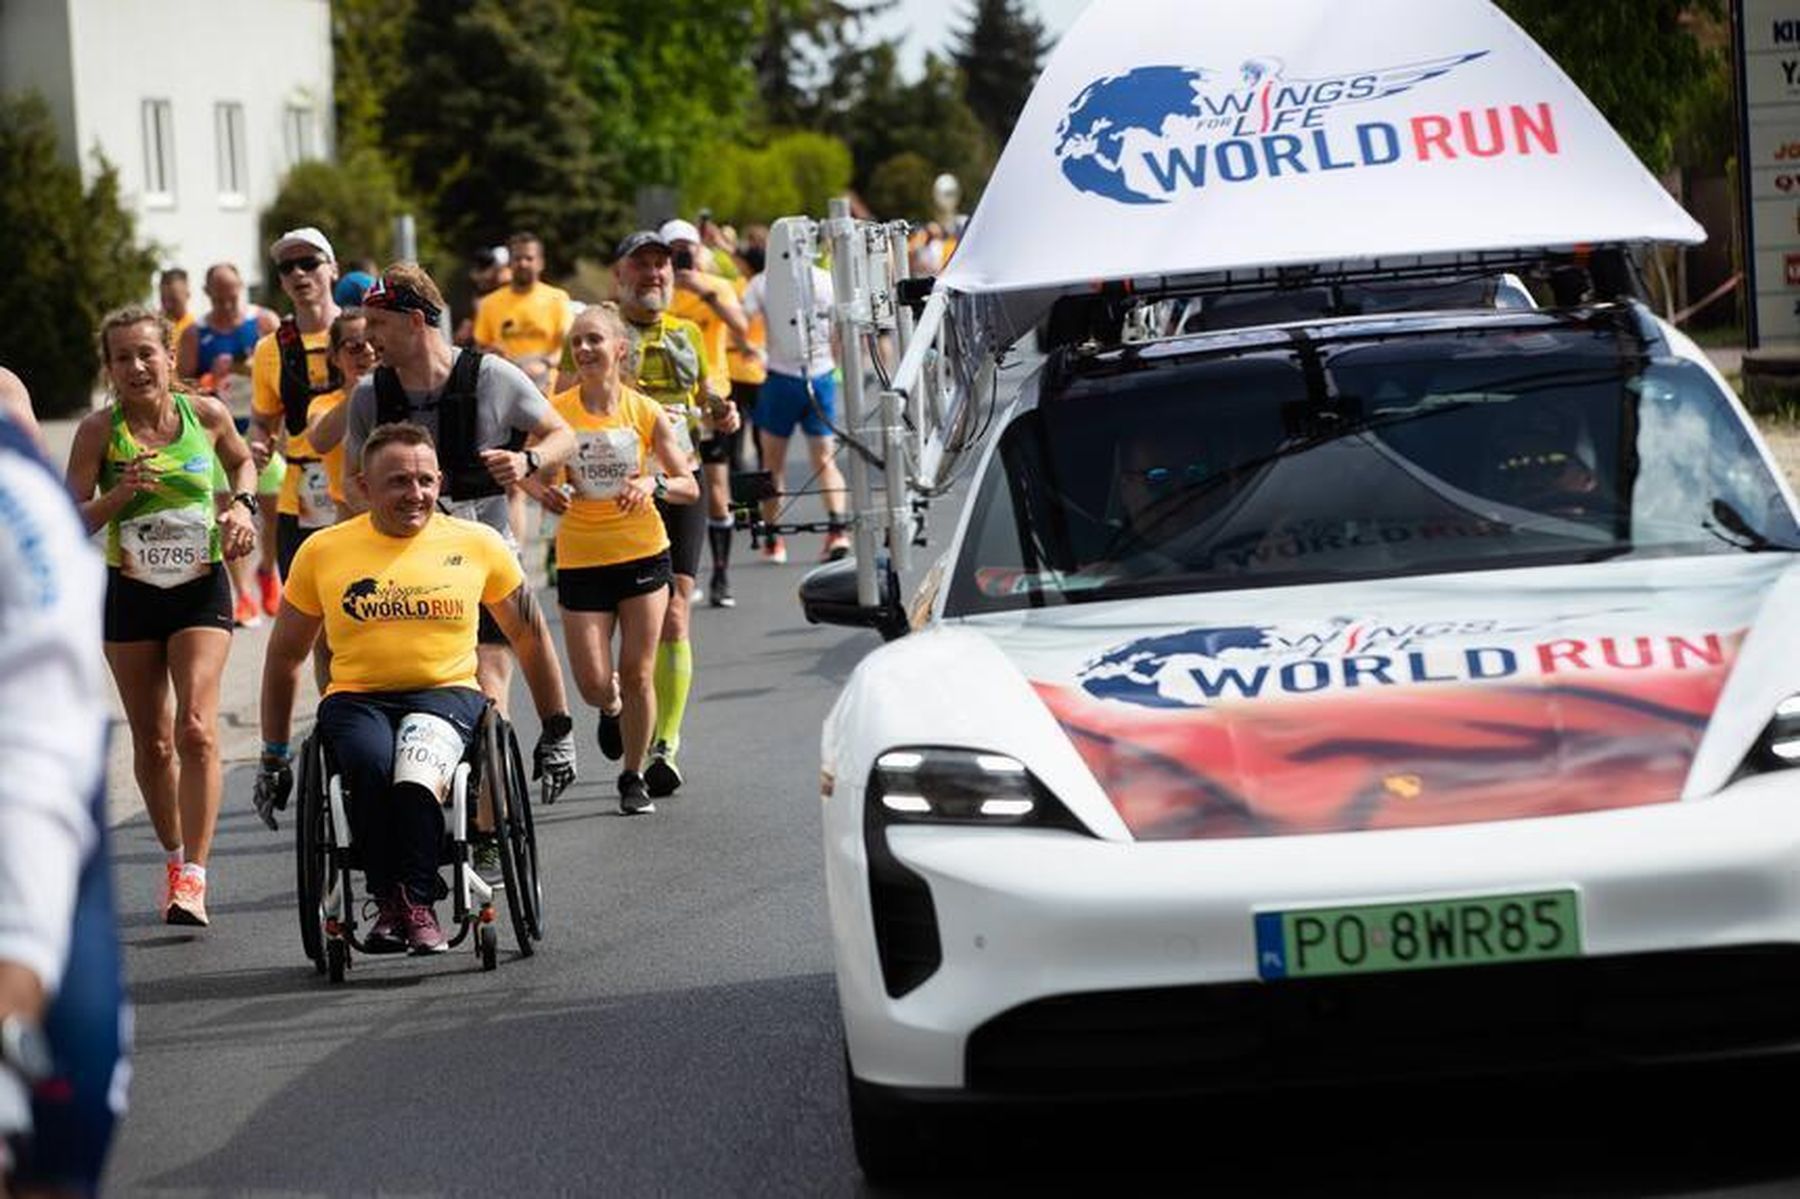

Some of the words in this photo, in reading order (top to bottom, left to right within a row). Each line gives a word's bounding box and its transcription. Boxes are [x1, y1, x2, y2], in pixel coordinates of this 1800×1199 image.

[1203, 75, 1378, 116] WINGS
[1196, 117, 1233, 131] FOR
[1232, 104, 1332, 137] LIFE
[1143, 121, 1401, 193] WORLD
[1410, 102, 1558, 161] RUN
[579, 462, 629, 480] 15862
[137, 547, 195, 565] 16785
[361, 600, 429, 618] WORLD
[431, 599, 463, 615] RUN
[1188, 647, 1518, 698] WORLD
[1535, 633, 1725, 675] RUN
[1293, 914, 1367, 968] PO
[1391, 899, 1564, 962] 8WR85
